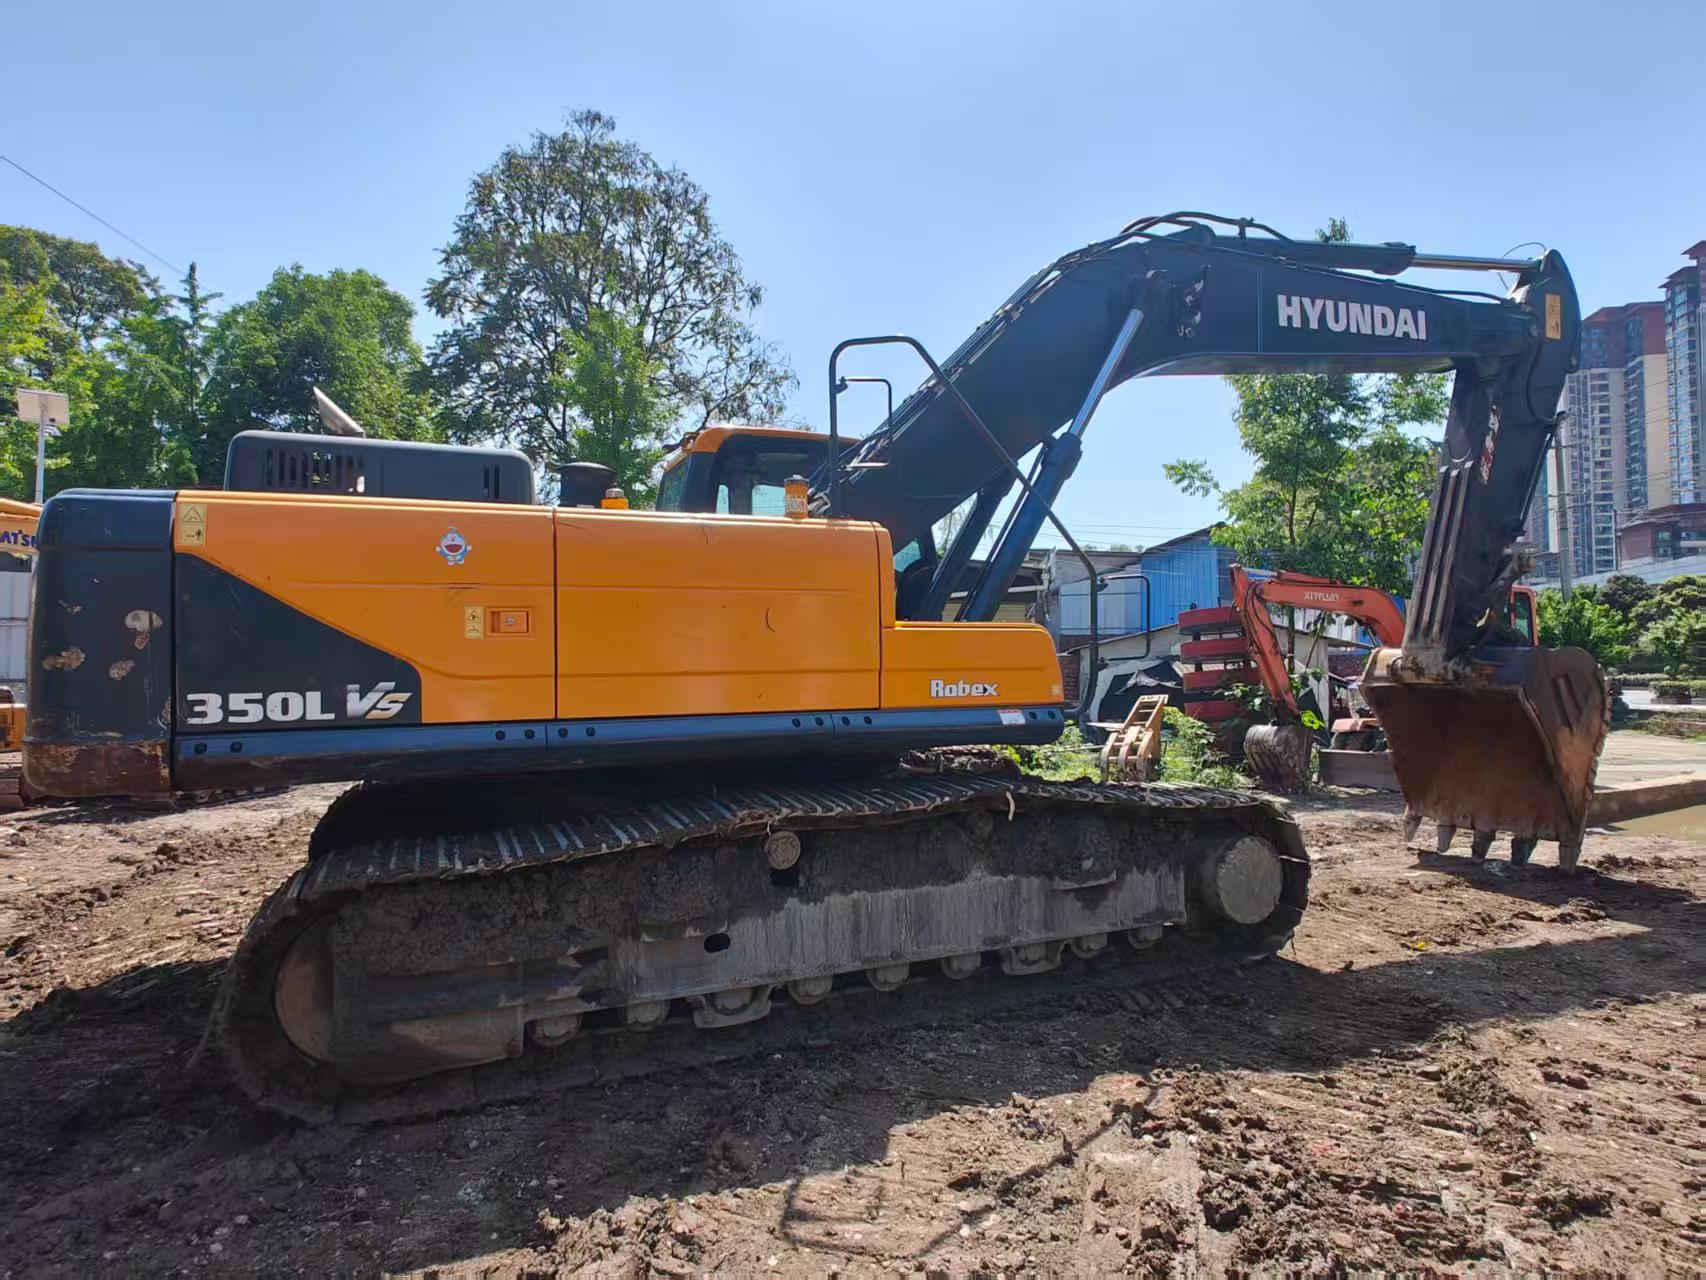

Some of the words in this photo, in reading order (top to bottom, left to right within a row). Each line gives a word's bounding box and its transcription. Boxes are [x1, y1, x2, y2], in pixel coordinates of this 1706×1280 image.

[1277, 294, 1427, 341] HYUNDAI
[930, 679, 1000, 698] Robex
[186, 691, 335, 725] 350L
